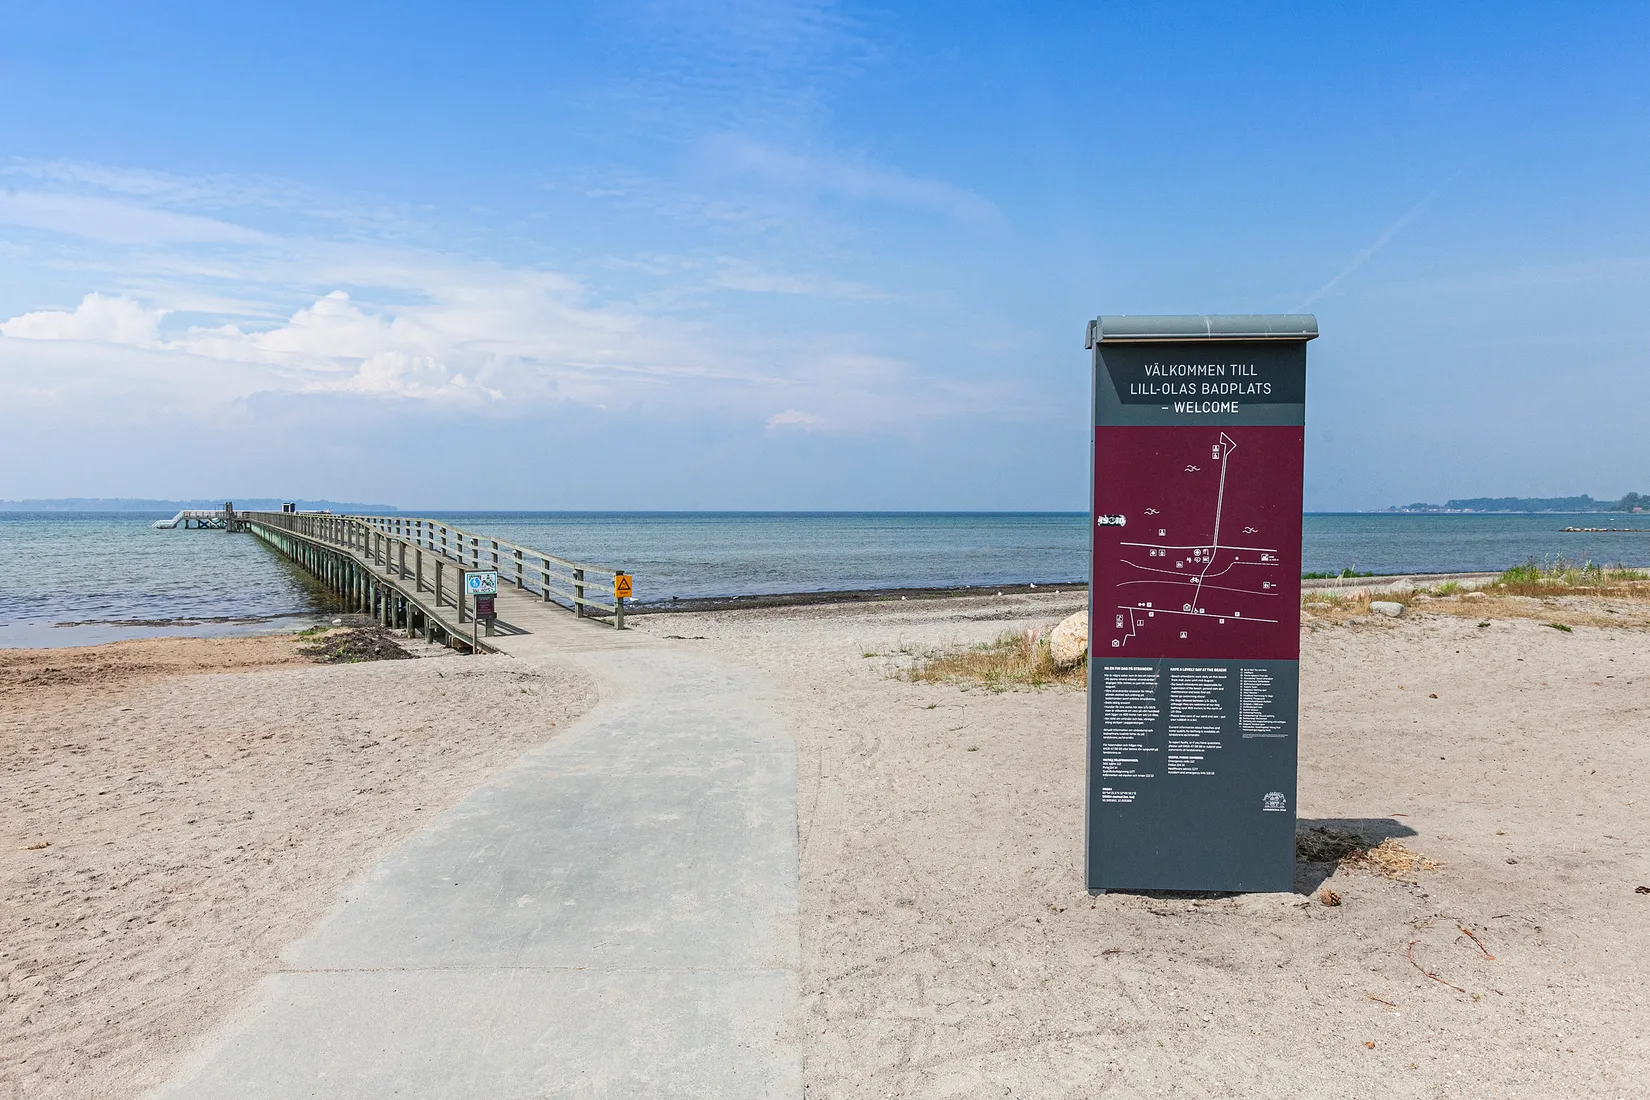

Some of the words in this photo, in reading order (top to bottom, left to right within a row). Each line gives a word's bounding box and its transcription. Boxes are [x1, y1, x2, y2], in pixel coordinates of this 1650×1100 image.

[1144, 362, 1225, 376] VÄLKOMMEN
[1230, 364, 1258, 376] TILL
[1130, 383, 1197, 395] LILL-OLAS
[1201, 382, 1272, 395] BADPLATS
[1174, 401, 1239, 413] WELCOME
